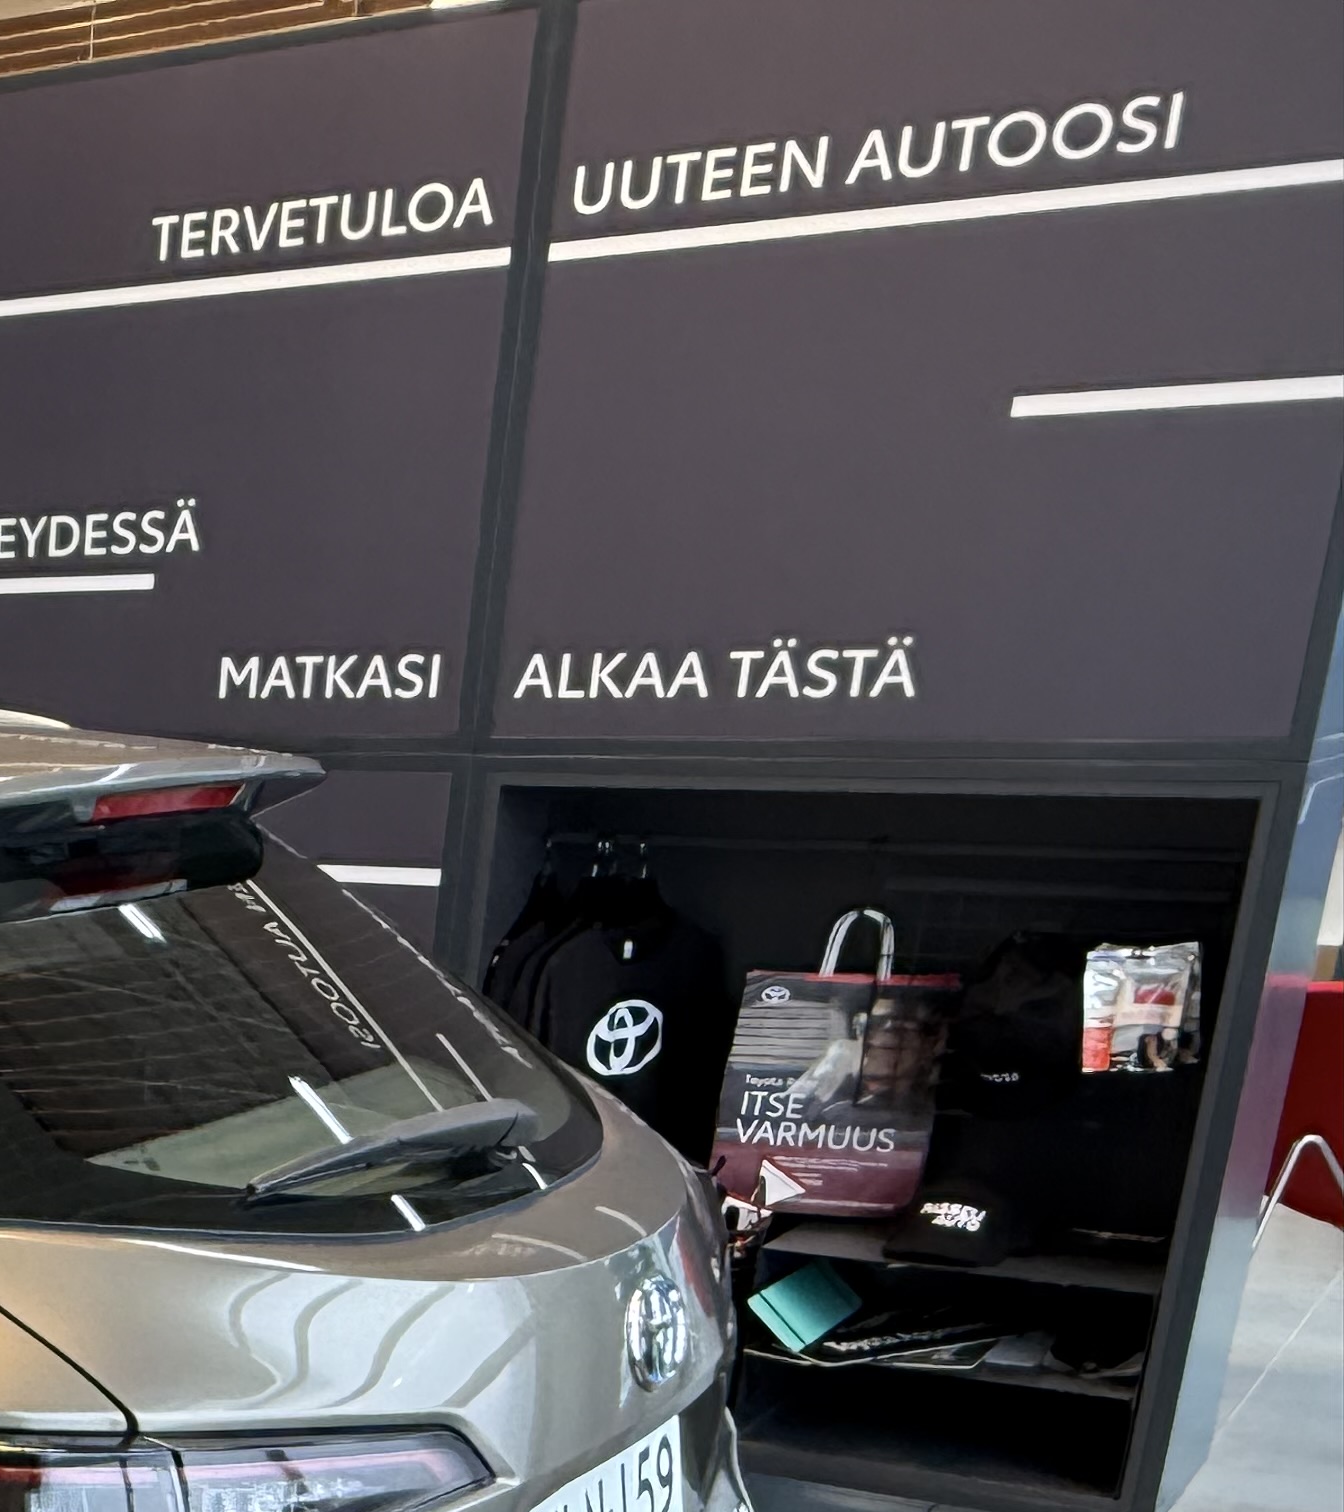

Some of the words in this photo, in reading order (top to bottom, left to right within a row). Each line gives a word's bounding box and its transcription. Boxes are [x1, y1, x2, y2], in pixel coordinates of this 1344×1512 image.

[153, 178, 493, 262] TERVETULOA
[573, 136, 830, 214] UUTEEN
[845, 91, 1185, 187] AUTOOSI
[218, 653, 441, 700] MATKASI
[513, 651, 709, 699] ALKAA
[729, 636, 916, 699] TÄSTÄ
[740, 1090, 806, 1119] ITSE
[736, 1118, 895, 1153] VARMUUS
